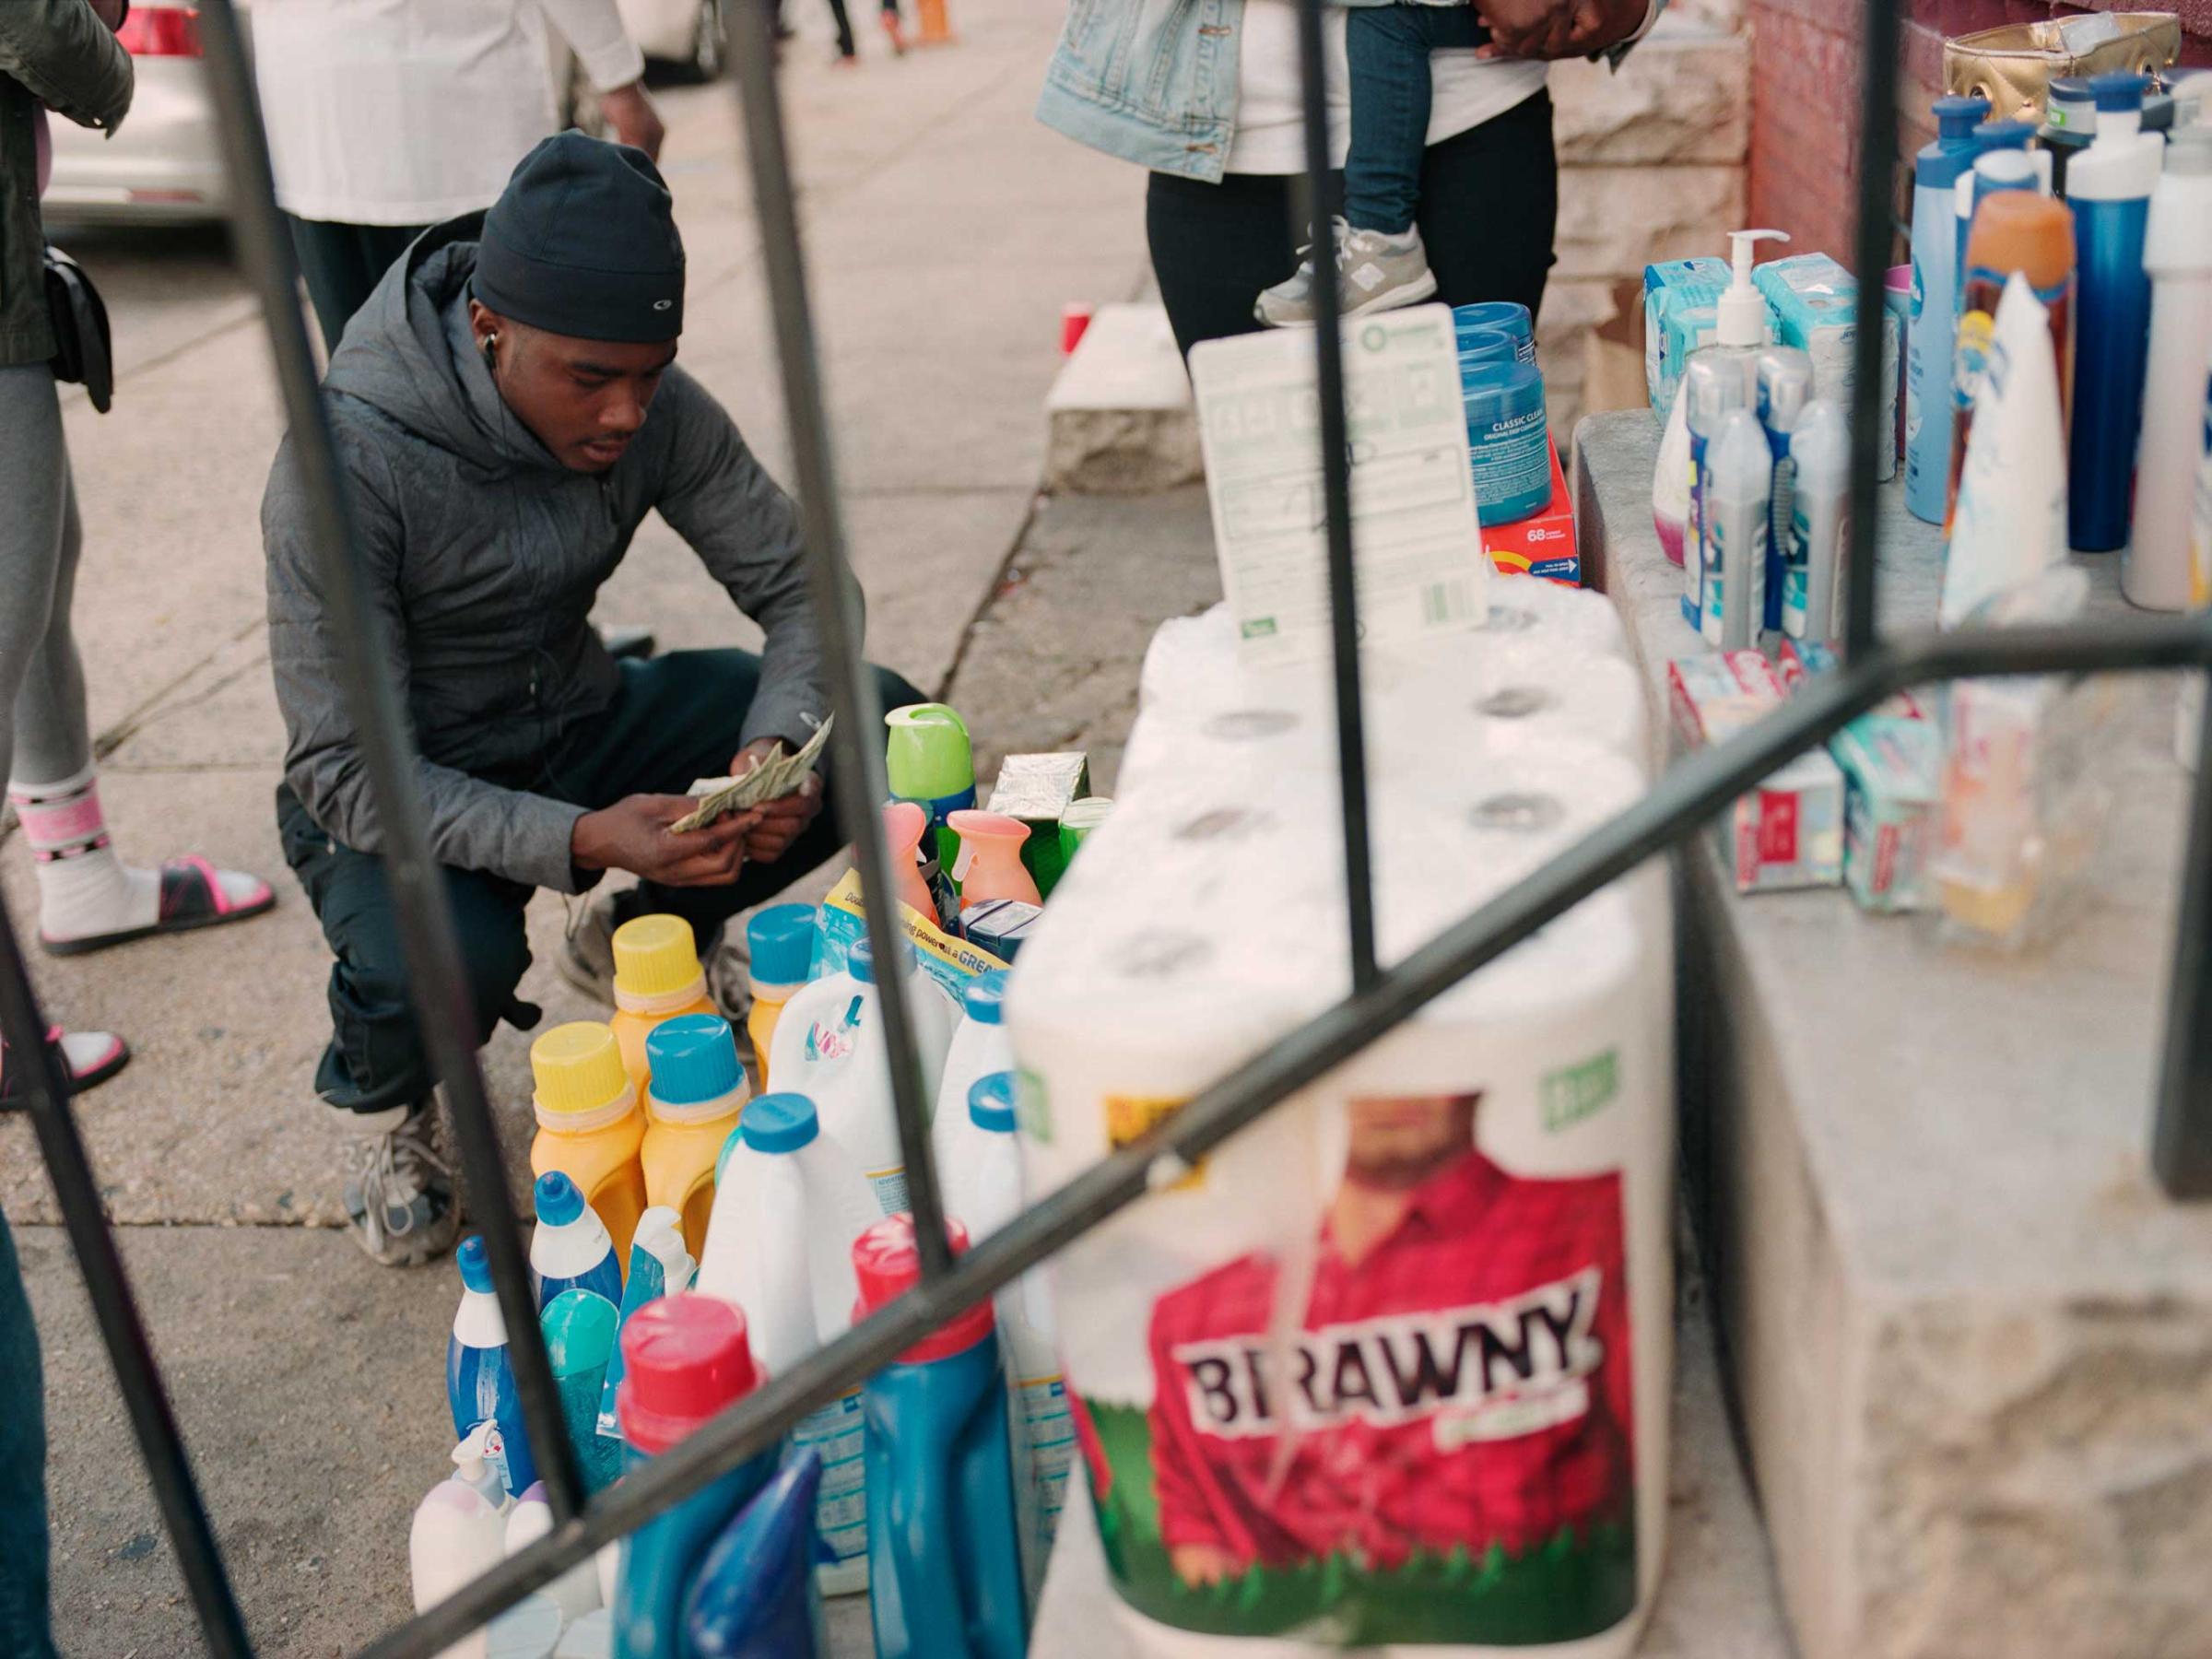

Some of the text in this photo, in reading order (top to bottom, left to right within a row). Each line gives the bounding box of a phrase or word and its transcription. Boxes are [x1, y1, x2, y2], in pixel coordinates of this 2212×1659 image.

[1492, 415, 1526, 432] CLASSIC
[1527, 528, 1546, 542] 68
[915, 928, 940, 948] power
[951, 948, 959, 959] a
[1186, 1290, 1580, 1422] BRAWNY
